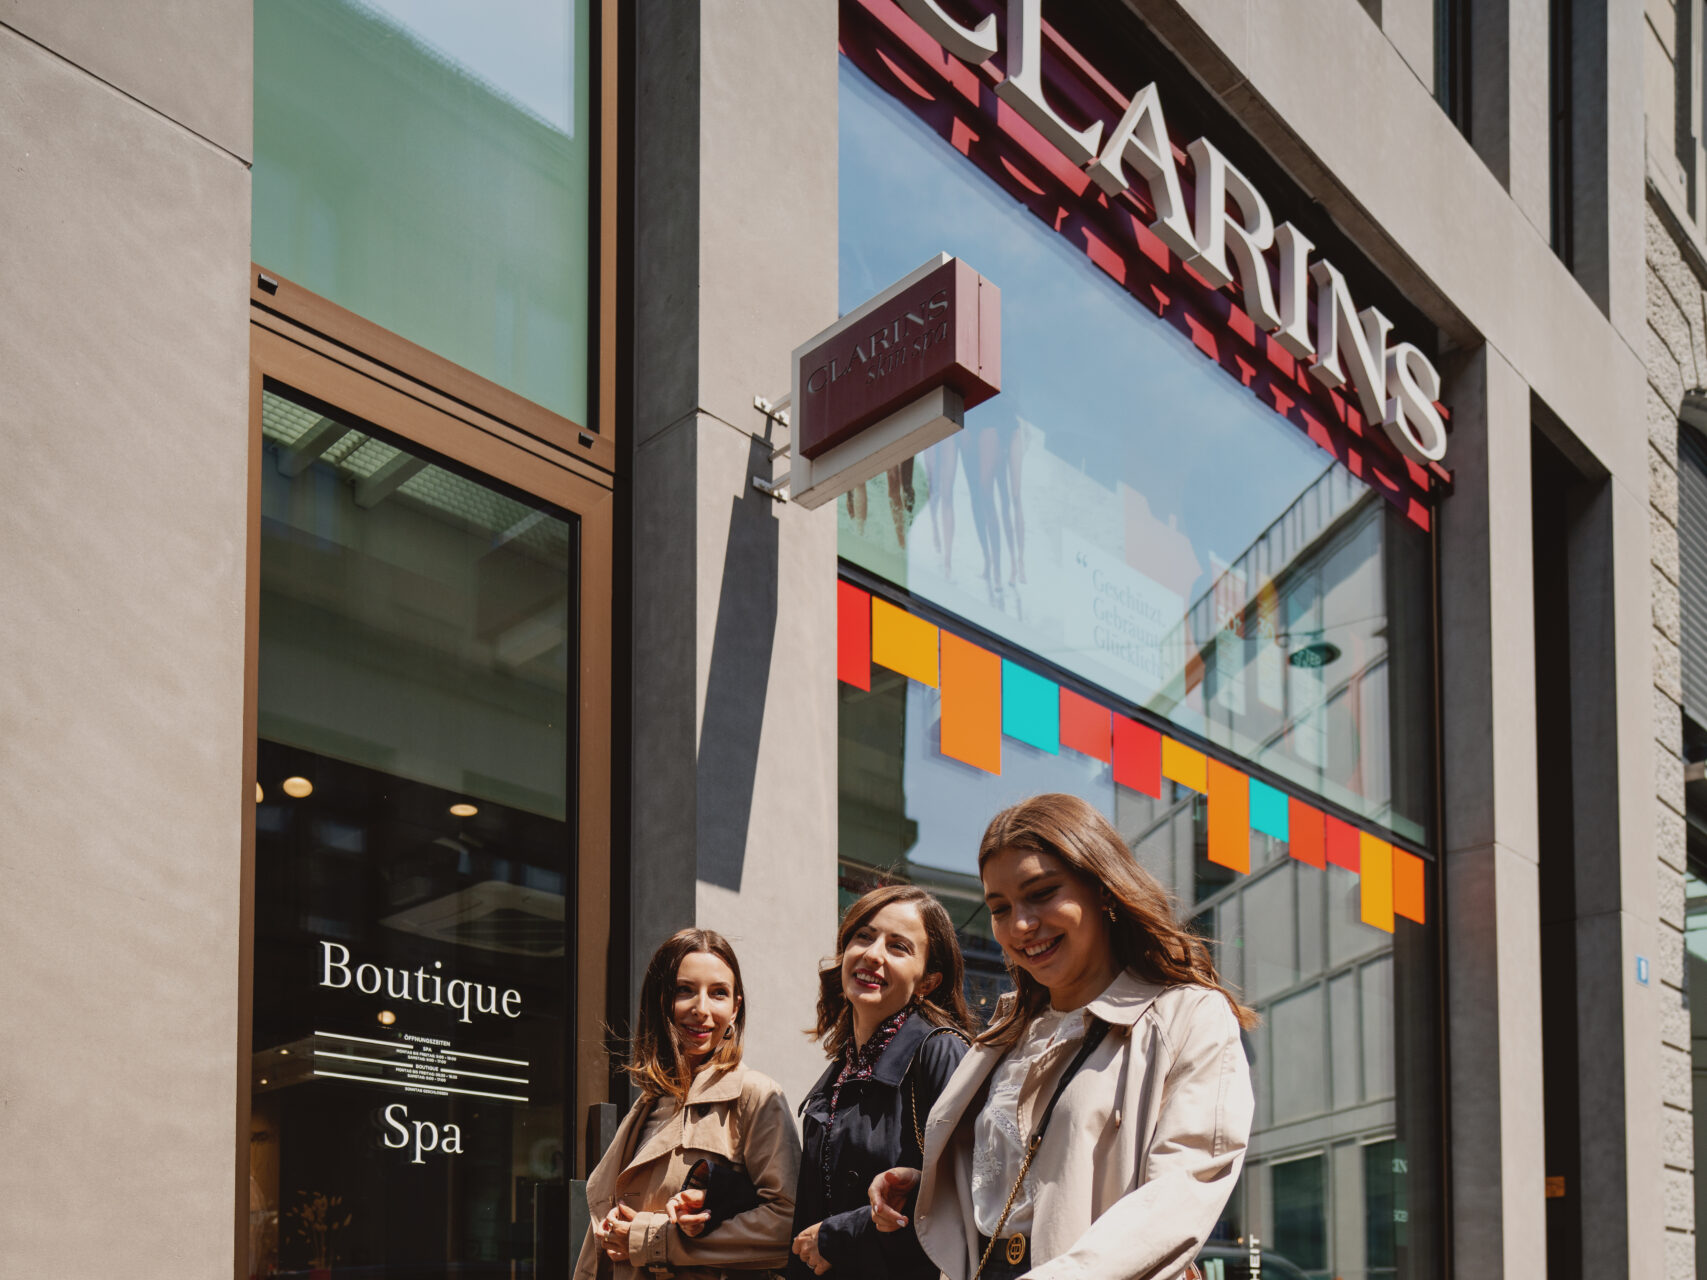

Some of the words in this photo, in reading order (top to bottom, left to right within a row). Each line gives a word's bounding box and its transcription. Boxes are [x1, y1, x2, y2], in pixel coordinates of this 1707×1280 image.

[806, 288, 949, 394] CLARINS
[865, 346, 907, 385] skin
[911, 320, 948, 359] spa
[319, 940, 522, 1024] Boutique
[384, 1103, 464, 1164] Spa
